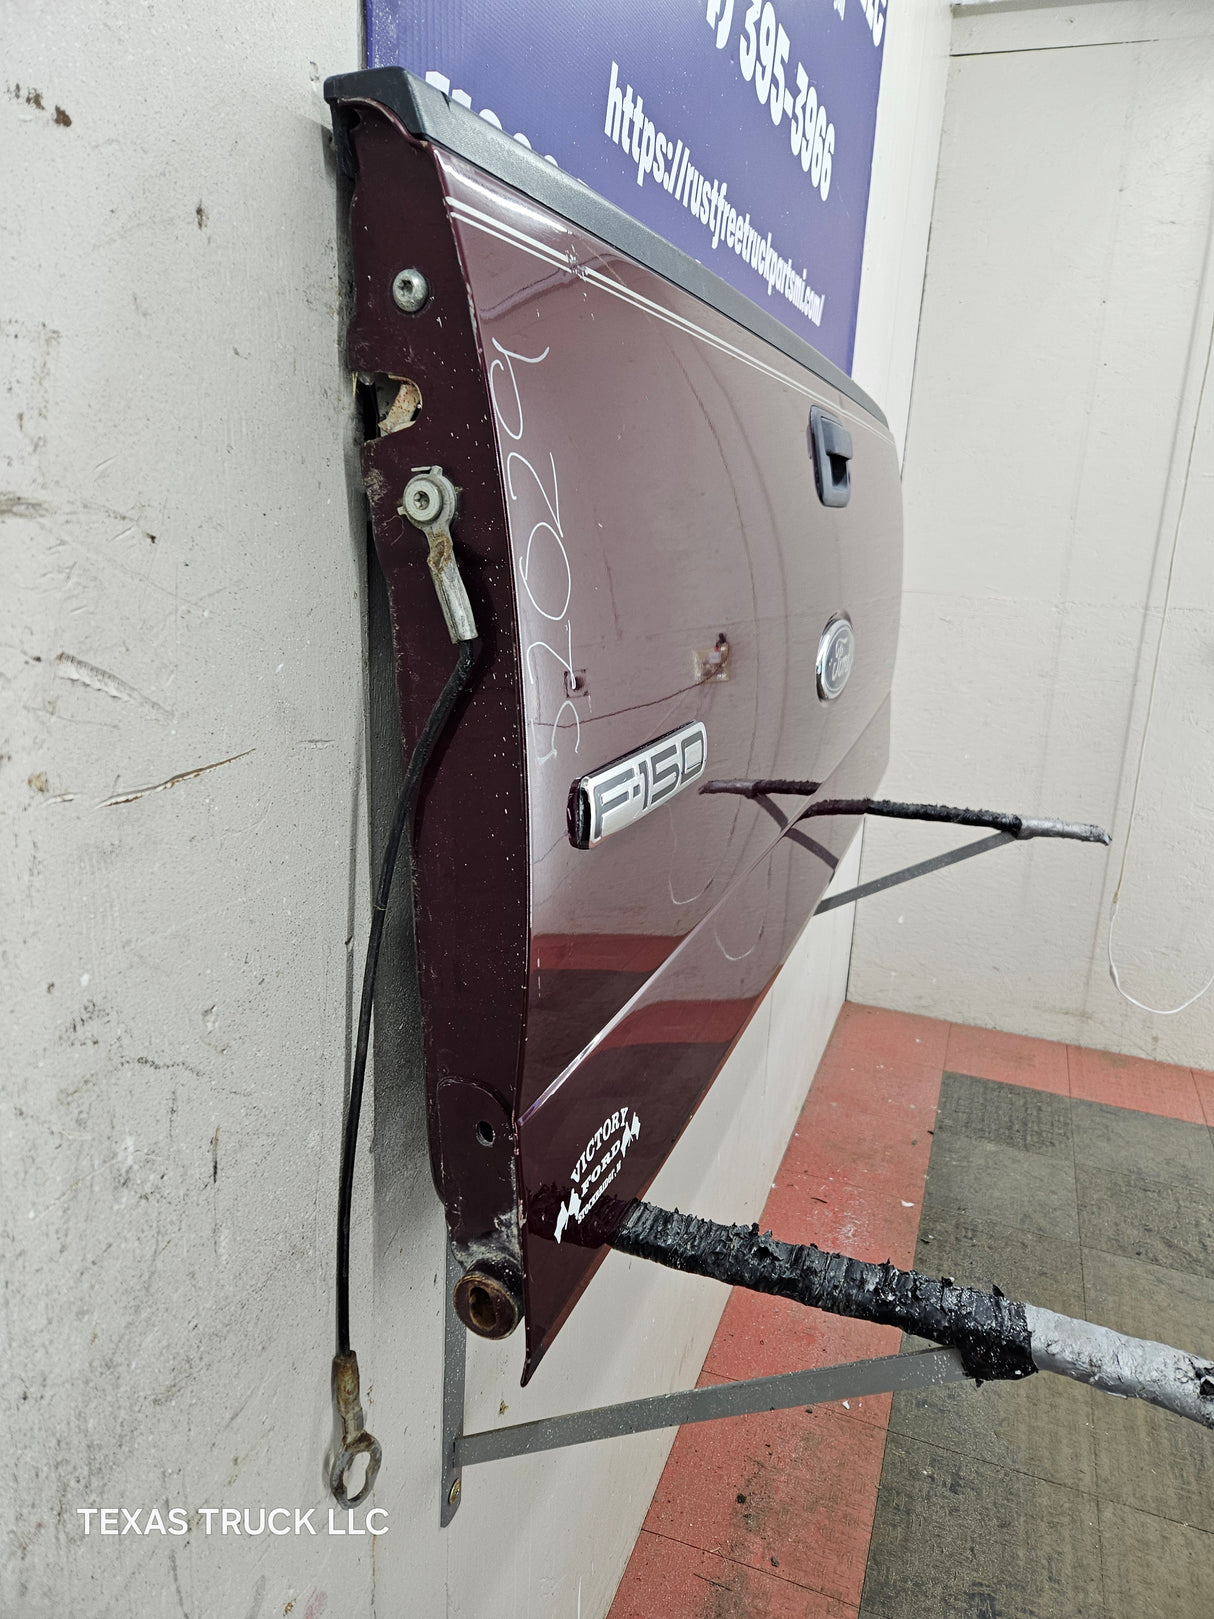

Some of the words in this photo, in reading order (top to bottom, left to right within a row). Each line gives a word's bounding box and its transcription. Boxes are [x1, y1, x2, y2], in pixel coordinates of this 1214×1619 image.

[740, 0, 835, 201] 395-3966
[604, 60, 825, 327] https://rustfreetruckpartsmi.com/
[593, 730, 704, 840] F-150
[570, 1107, 629, 1183] VICTORY
[581, 1140, 621, 1197] FORD
